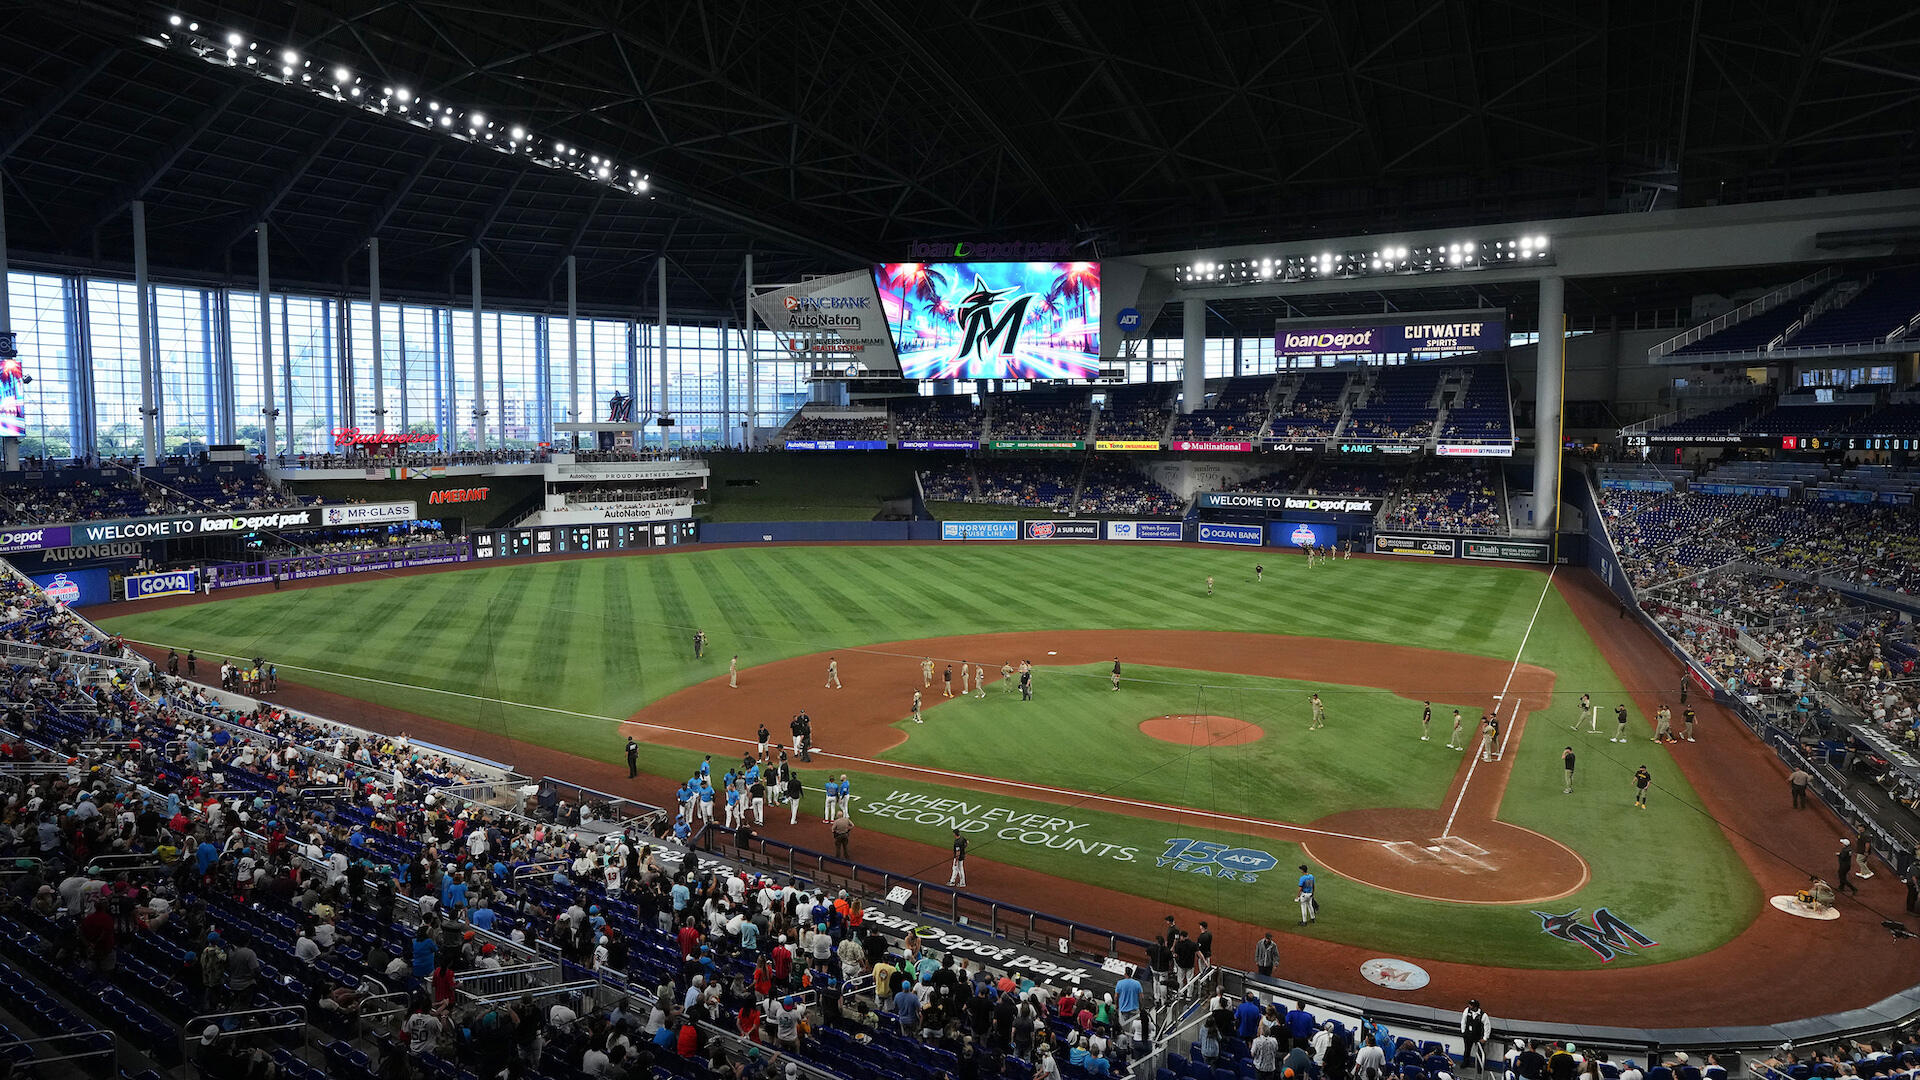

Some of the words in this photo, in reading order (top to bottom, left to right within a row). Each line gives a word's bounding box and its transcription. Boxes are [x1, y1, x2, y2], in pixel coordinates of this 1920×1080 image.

[911, 241, 1023, 260] loanDepot
[1024, 240, 1072, 260] park
[788, 314, 860, 326] AutoNation
[1120, 315, 1139, 325] ADT
[1404, 323, 1481, 339] CUTWATER
[1284, 330, 1372, 350] loanDepot
[1426, 338, 1457, 347] SPIRITS
[330, 427, 439, 447] Budweiser
[1627, 437, 1647, 446] 2:39
[1190, 442, 1241, 450] Multinational
[1350, 445, 1373, 453] AMG
[1849, 439, 1854, 448] 5
[428, 487, 490, 505] AMERANT
[1210, 495, 1263, 507] WELCOME
[1266, 497, 1281, 508] TO
[1285, 498, 1344, 512] loanDepot
[1344, 499, 1373, 514] park
[604, 510, 651, 519] AutoNation
[655, 507, 675, 516] Alley
[86, 522, 170, 541] WELCOME
[173, 520, 194, 534] TO
[200, 513, 279, 532] loanDepot
[278, 511, 311, 529] park
[654, 526, 666, 534] OAK
[1114, 524, 1131, 533] 150
[538, 531, 551, 540] HOU
[560, 530, 564, 539] 1
[596, 528, 608, 538] TEX
[630, 532, 634, 541] 5
[1211, 530, 1239, 538] OCEAN
[1240, 531, 1260, 540] BANK
[478, 535, 492, 546] LAA
[500, 534, 506, 544] 6
[513, 538, 518, 548] 9
[596, 540, 610, 549] NYY
[618, 538, 624, 548] 2
[654, 536, 666, 546] TOR
[42, 542, 142, 562] AutoNation
[476, 548, 494, 558] WSH
[500, 546, 506, 556] 2
[141, 575, 187, 594] GOYA
[886, 790, 982, 816] WHEN
[980, 807, 1091, 834] EVERY
[858, 802, 990, 833] SECOND
[997, 827, 1140, 863] COUNTS.
[1223, 854, 1268, 866] ADT
[608, 872, 617, 880] 13
[1156, 857, 1260, 883] YEARS
[862, 906, 1017, 960] loanDepot
[1003, 954, 1092, 985] park
[412, 1029, 428, 1042] 50
